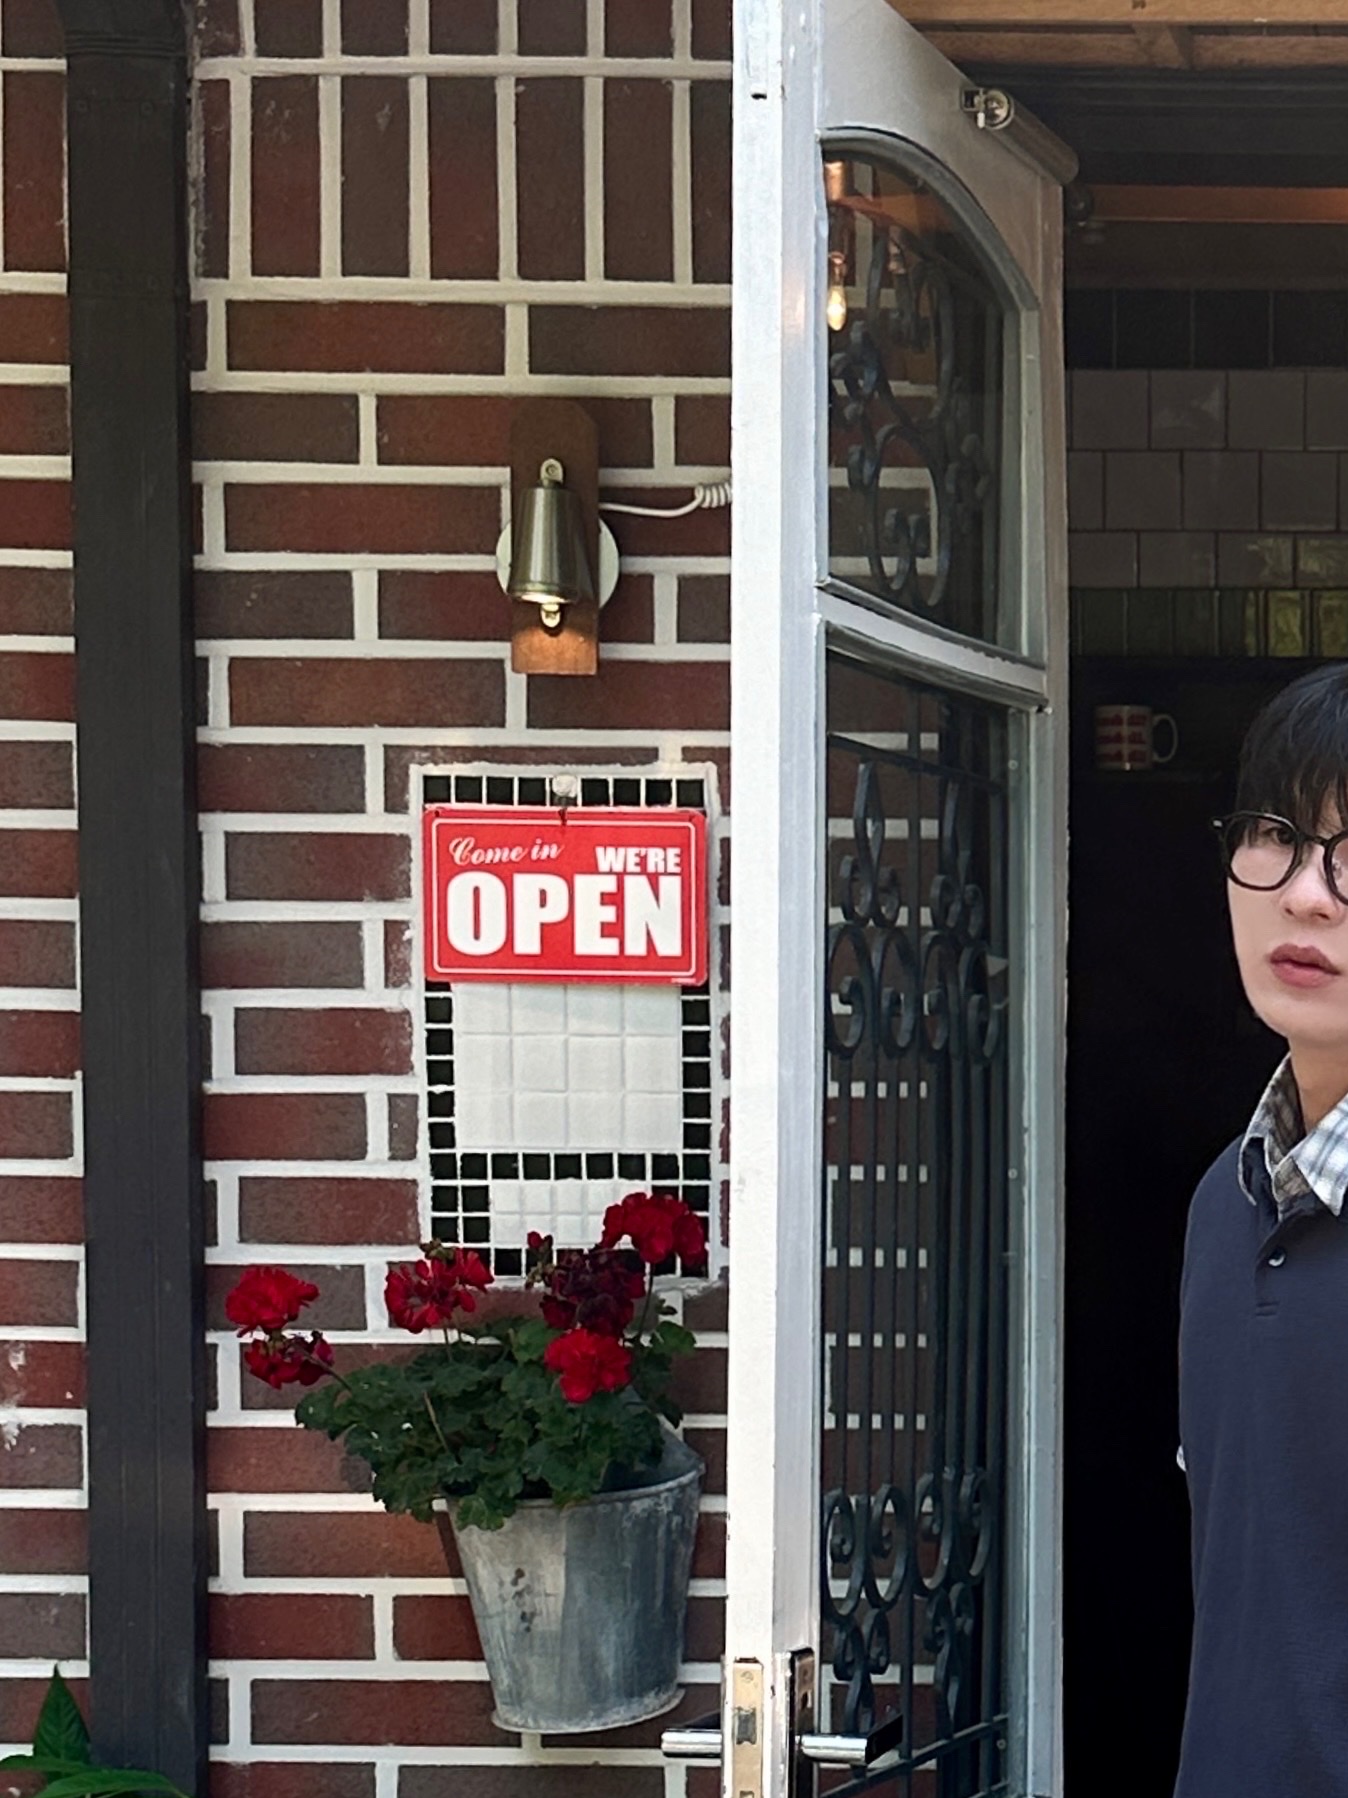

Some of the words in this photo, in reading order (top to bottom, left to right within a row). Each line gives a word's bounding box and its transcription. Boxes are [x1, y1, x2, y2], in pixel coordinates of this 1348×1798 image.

[449, 837, 528, 866] Come
[530, 838, 565, 862] in
[595, 846, 682, 874] WE'RE
[446, 870, 682, 957] OPEN
